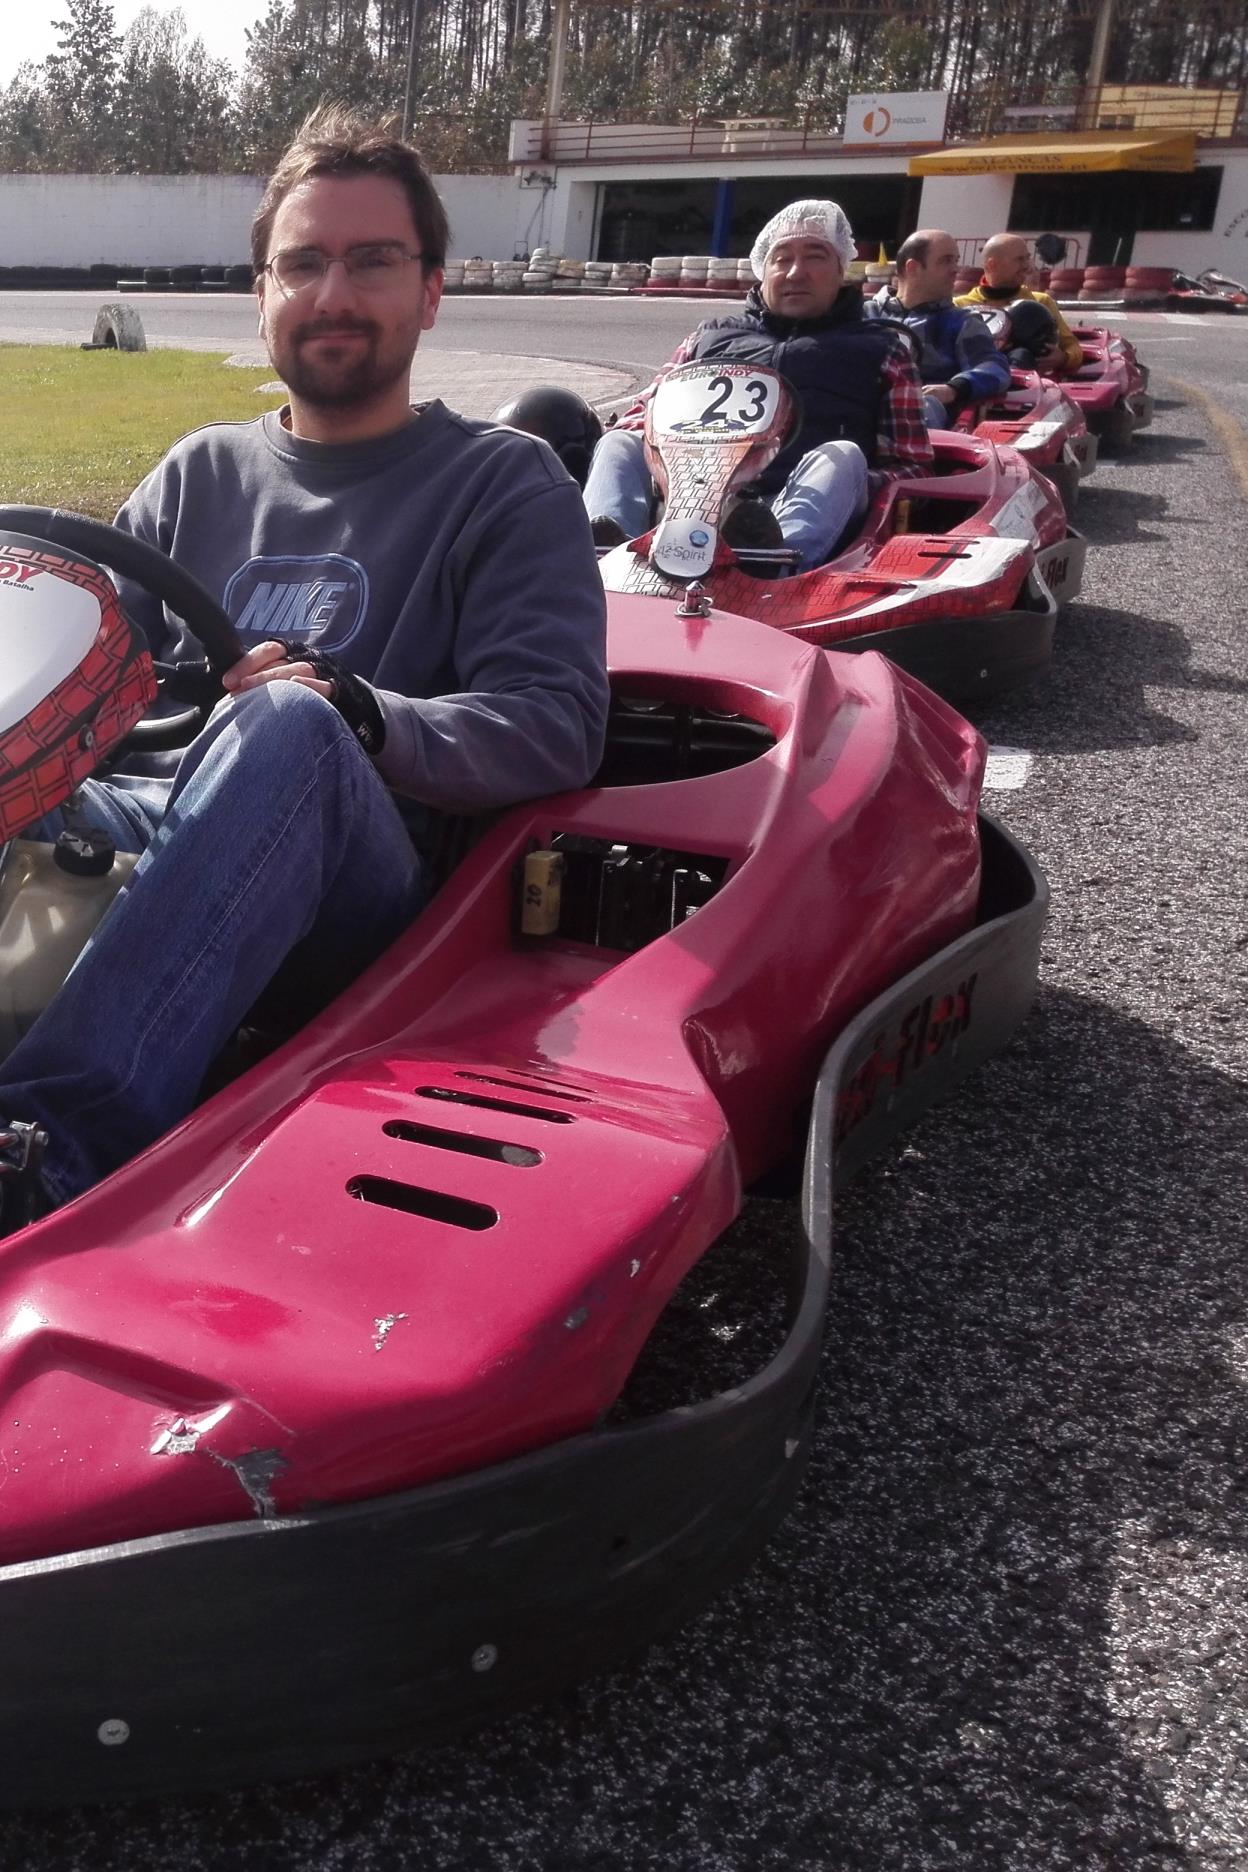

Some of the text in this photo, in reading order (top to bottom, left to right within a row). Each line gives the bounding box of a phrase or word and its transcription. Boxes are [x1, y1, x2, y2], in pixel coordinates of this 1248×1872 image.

[700, 376, 768, 422] 23
[3, 580, 34, 592] Batalha
[234, 581, 348, 632] NIKE
